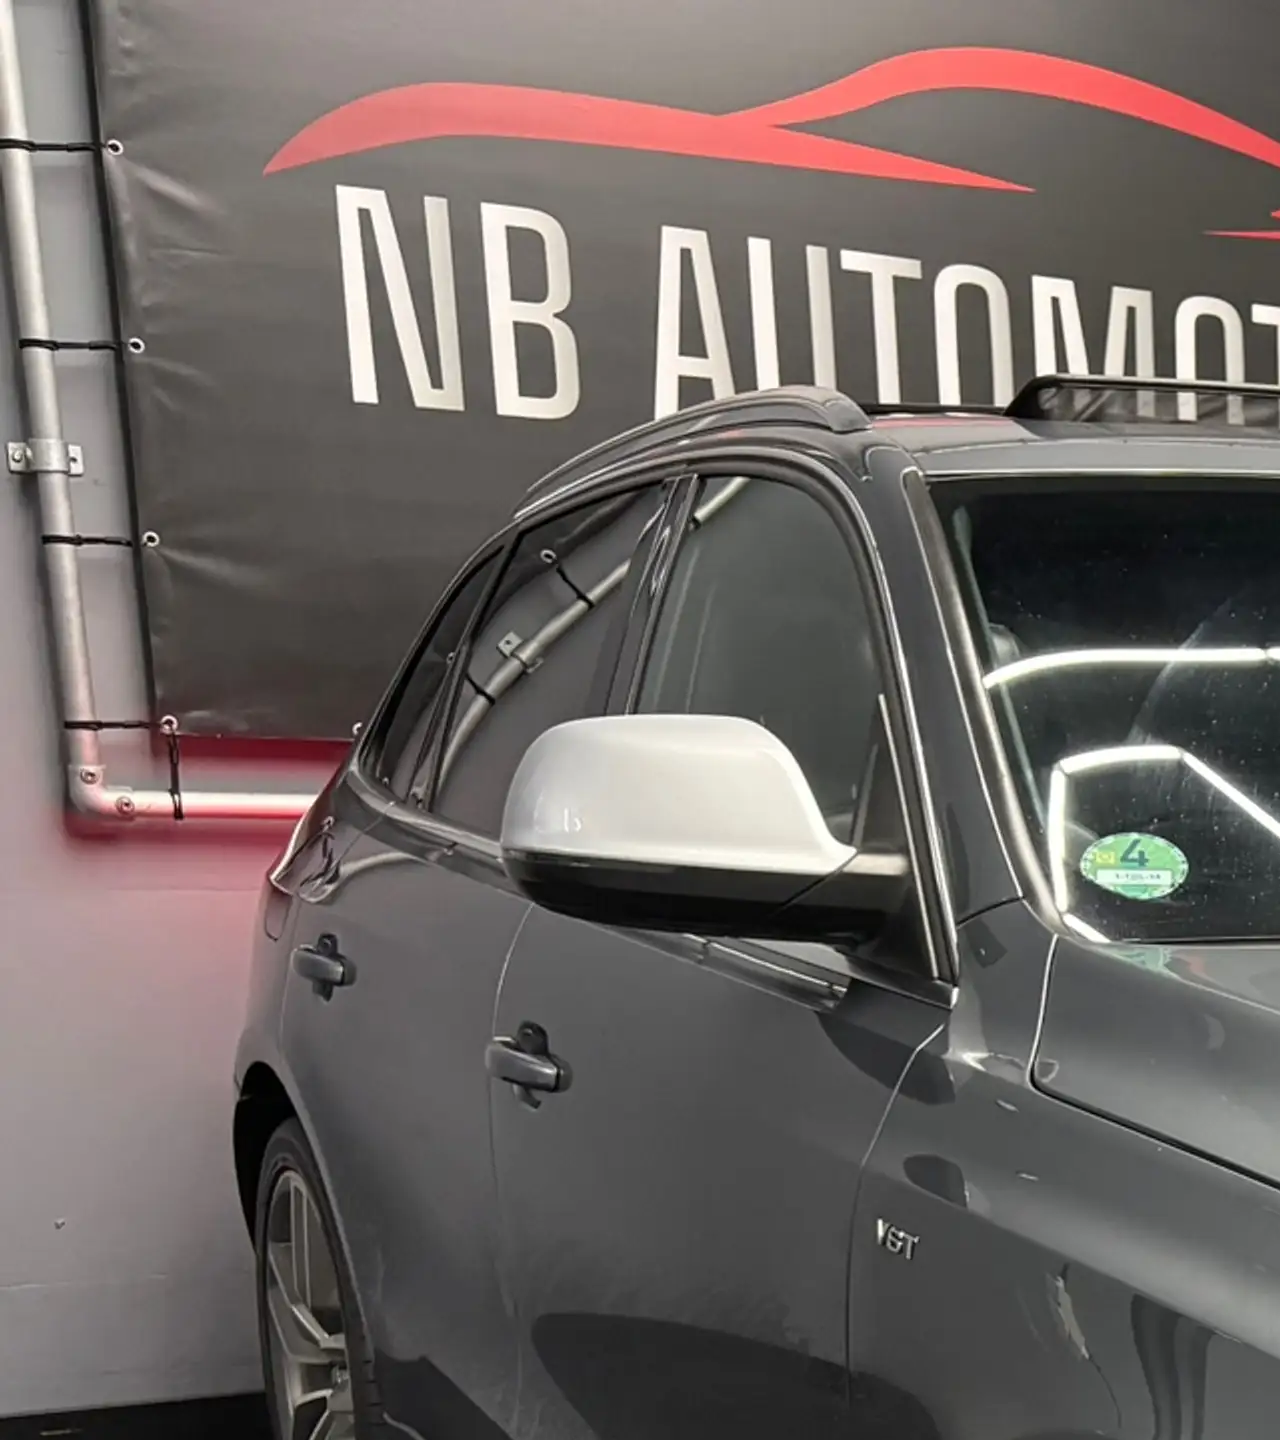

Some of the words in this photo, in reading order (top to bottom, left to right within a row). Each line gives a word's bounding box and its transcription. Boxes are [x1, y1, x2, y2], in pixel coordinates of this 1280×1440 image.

[336, 184, 580, 421] NB
[1120, 838, 1149, 867] 4
[877, 1218, 920, 1260] V6T
